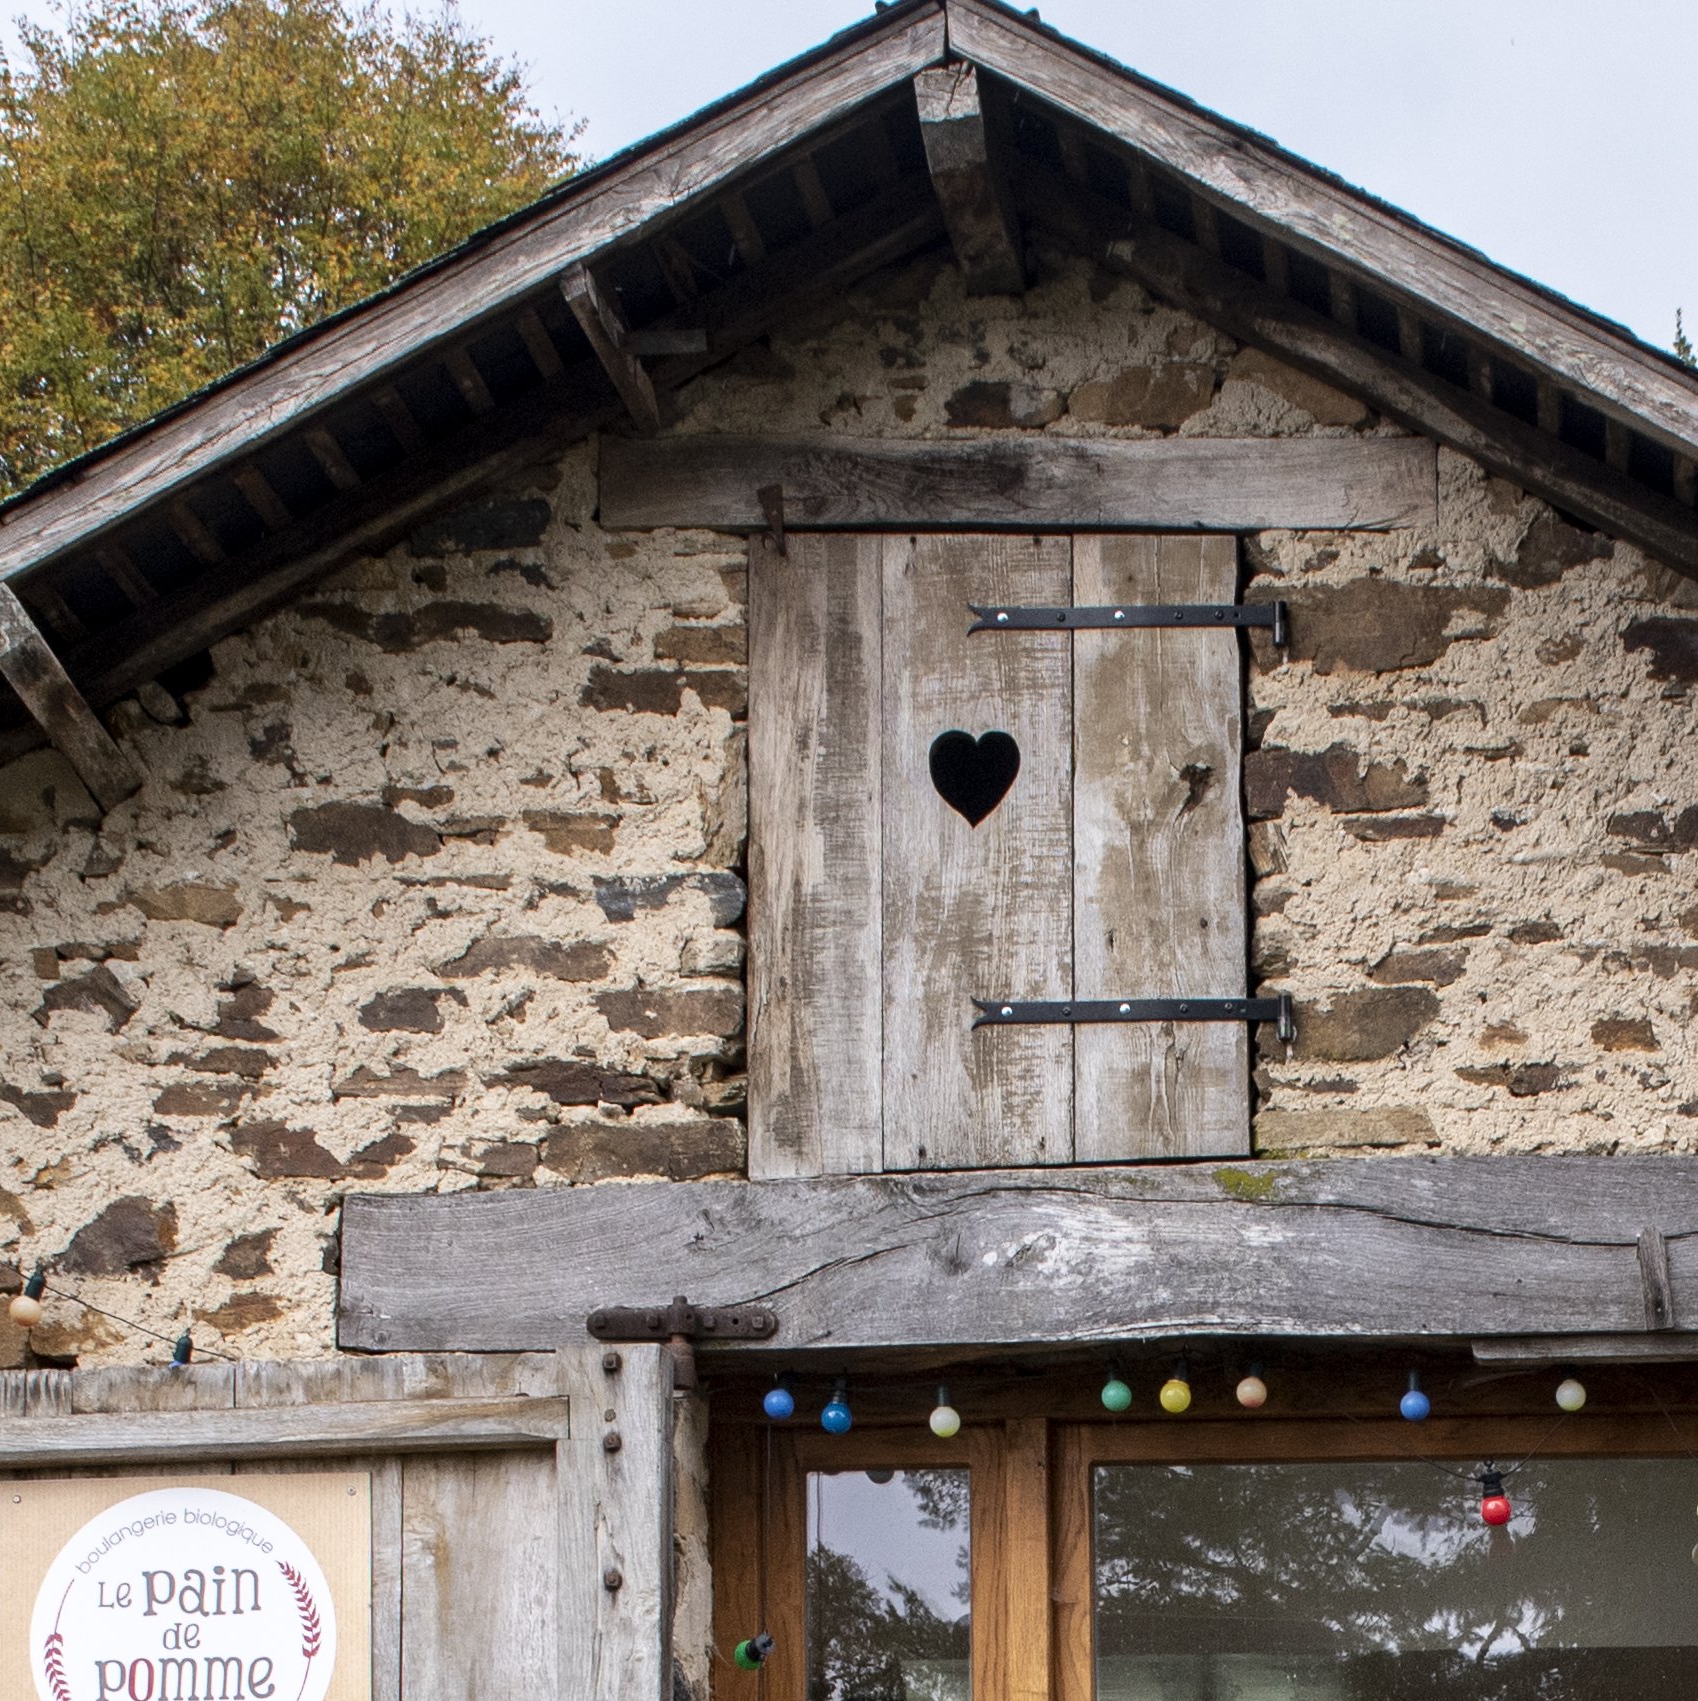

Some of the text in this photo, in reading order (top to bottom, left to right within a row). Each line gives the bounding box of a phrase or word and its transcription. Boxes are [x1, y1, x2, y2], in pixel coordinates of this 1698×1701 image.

[75, 1508, 273, 1574] boulangerie biologique
[97, 1565, 262, 1617] Le pain
[162, 1622, 201, 1649] de
